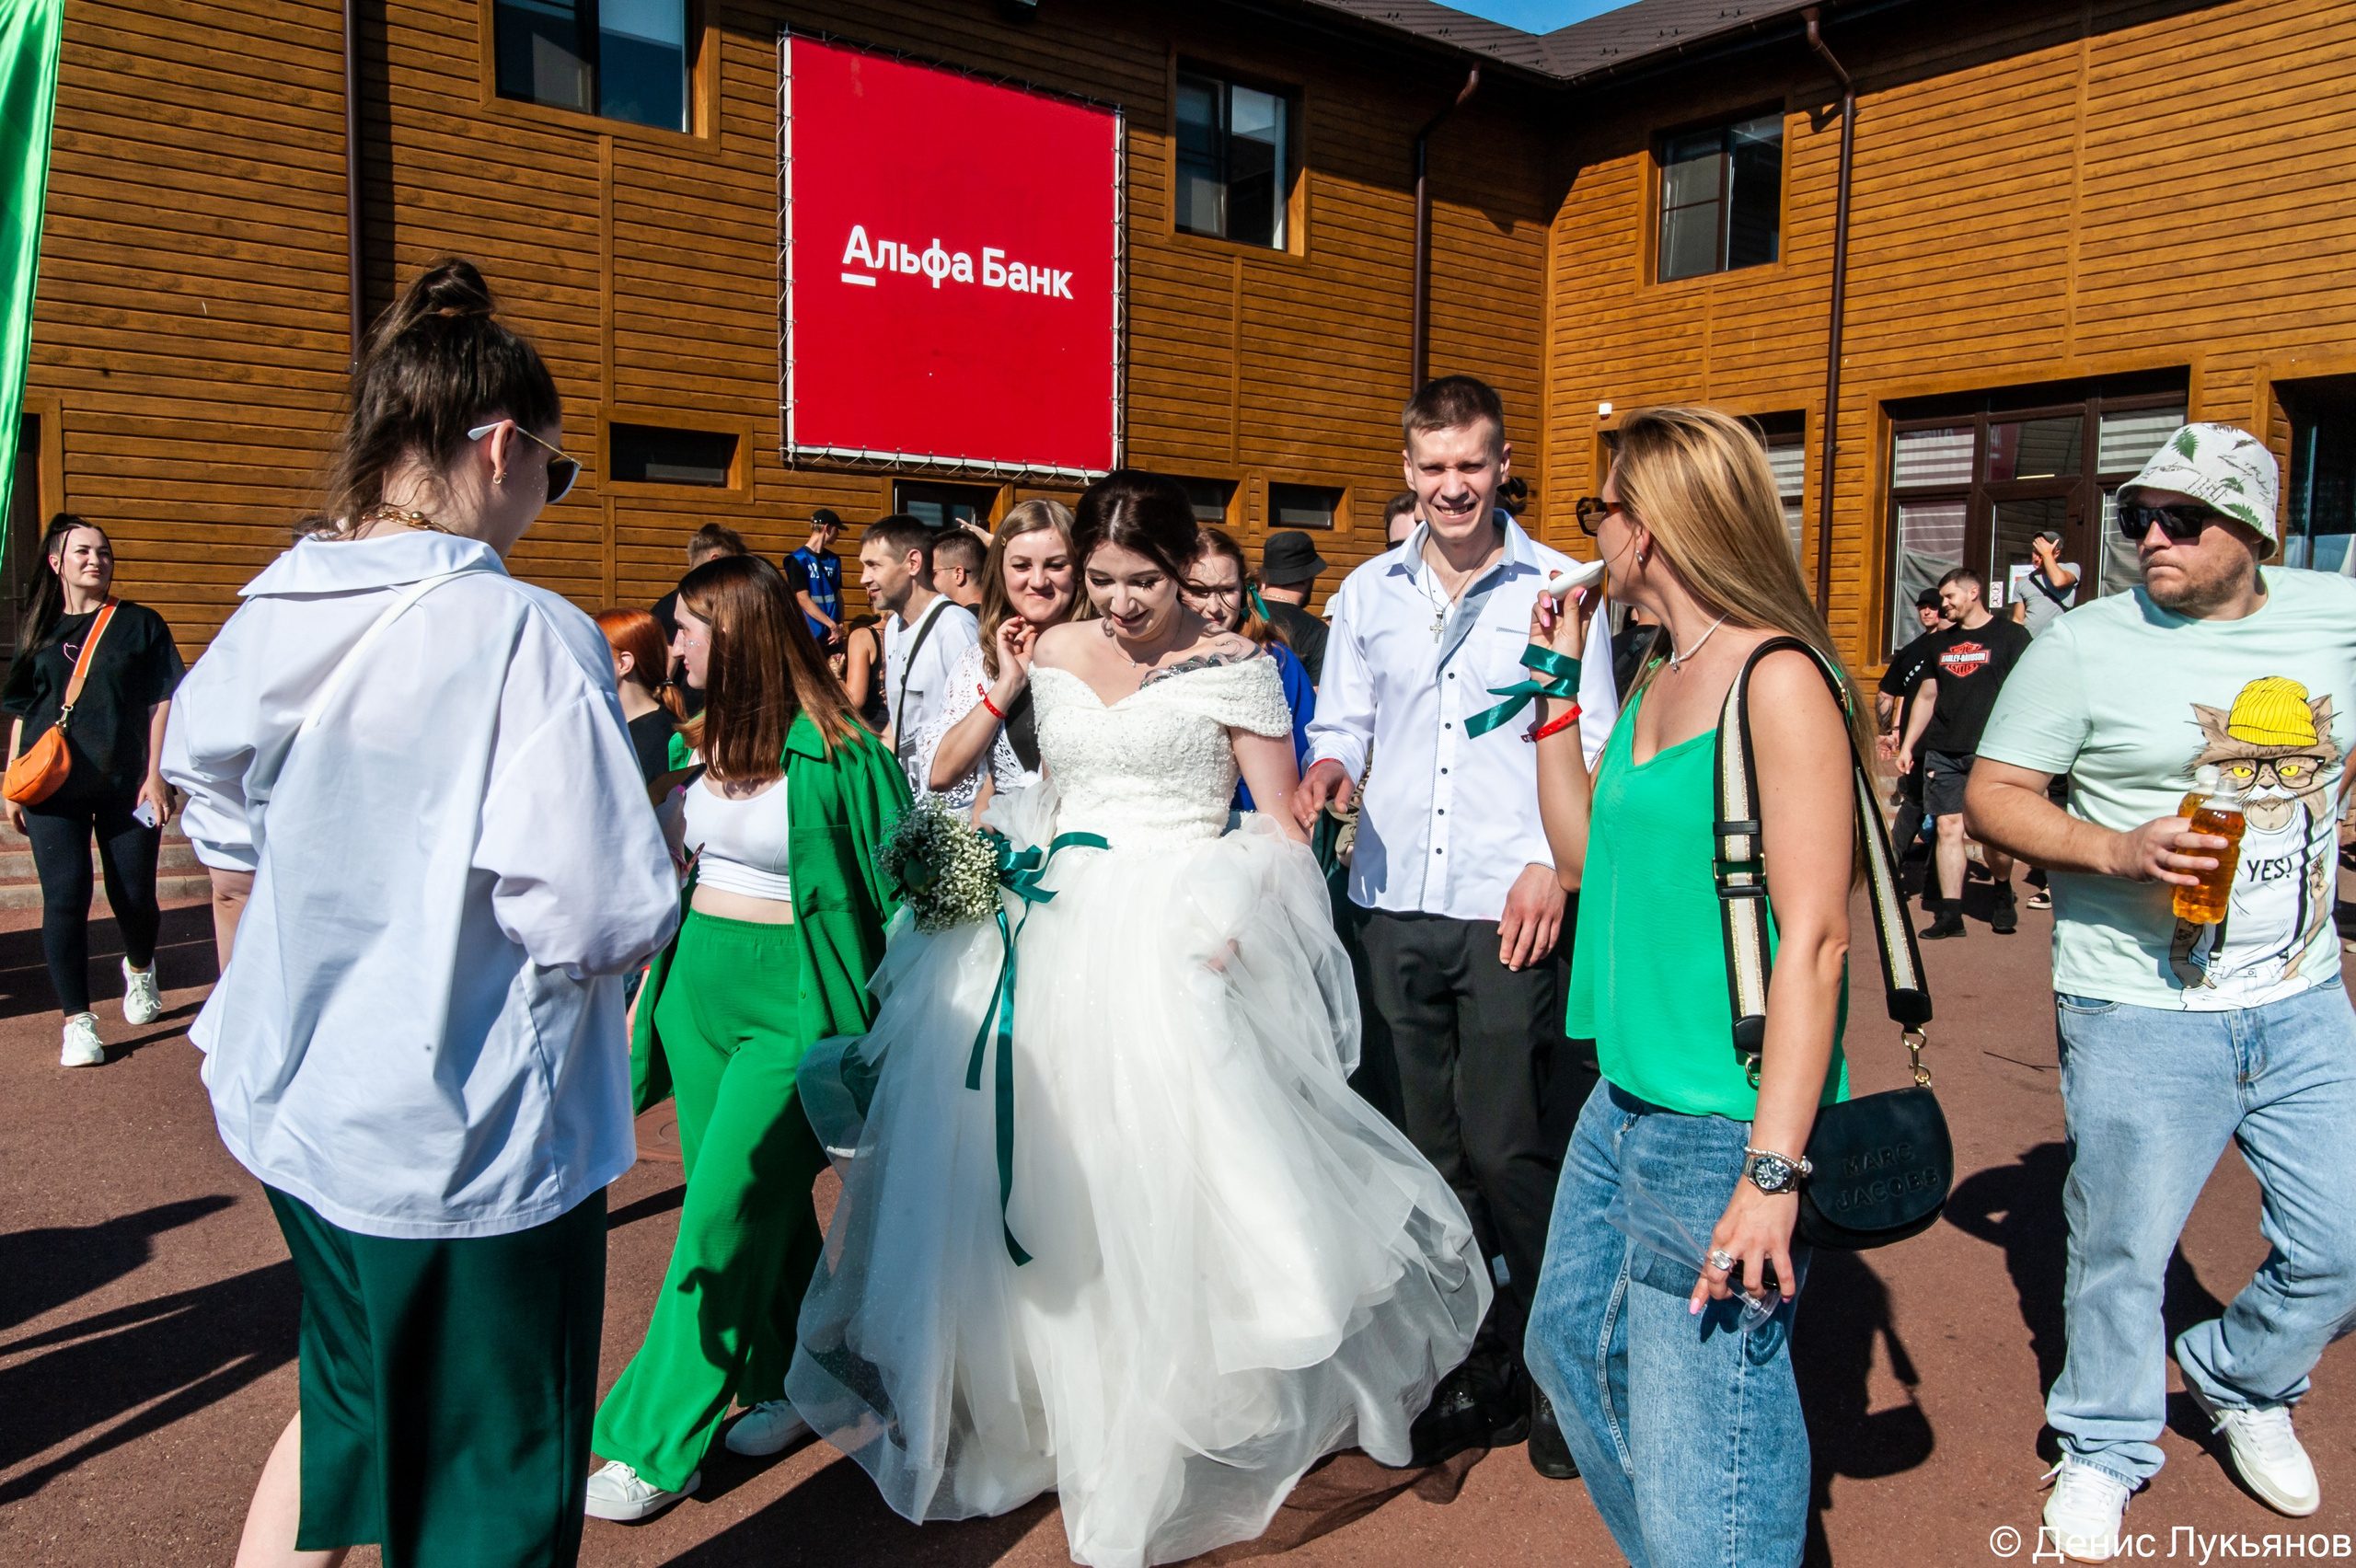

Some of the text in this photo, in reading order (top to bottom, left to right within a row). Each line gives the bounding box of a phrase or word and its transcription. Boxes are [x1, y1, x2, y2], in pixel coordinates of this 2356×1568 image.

[841, 225, 1074, 300] Альфа Банк
[1950, 663, 1975, 674] CYCLES
[2246, 857, 2292, 882] YES!
[1842, 1142, 1916, 1178] MARC
[1836, 1166, 1941, 1212] JACOBS
